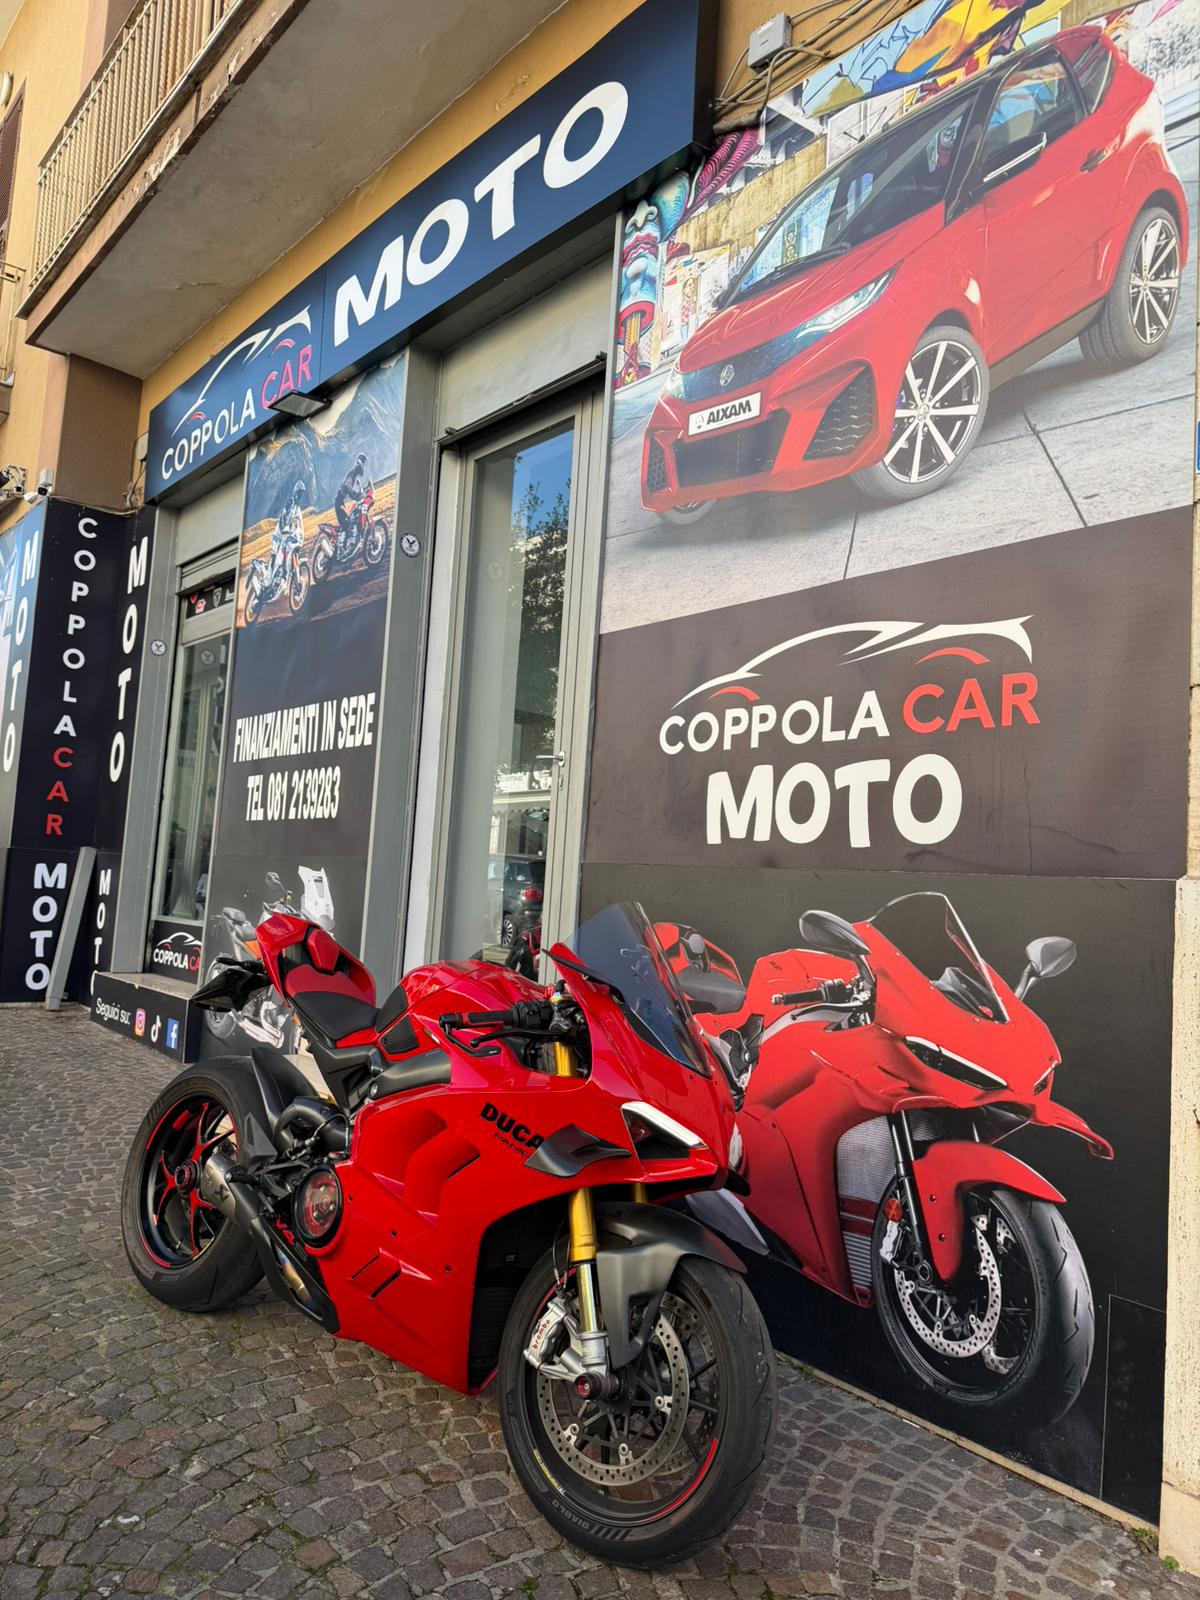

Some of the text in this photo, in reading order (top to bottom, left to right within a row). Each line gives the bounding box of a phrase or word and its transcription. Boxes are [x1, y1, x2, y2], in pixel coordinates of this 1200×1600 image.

[334, 81, 629, 347] MOTO
[162, 345, 313, 480] COPPOLA CAR
[707, 400, 752, 425] AIXAM
[3, 530, 39, 773] MOTO
[109, 536, 148, 783] MOTO
[233, 692, 376, 763] FINANZIAMENTI IN SEDE
[659, 672, 1041, 755] COPPOLA CAR
[246, 765, 341, 821] TEL 081 2139283
[706, 753, 963, 849] MOTO
[25, 862, 67, 991] MOTO
[153, 948, 202, 971] COPPOLA CA
[96, 997, 119, 1021] Seguici
[480, 1102, 545, 1151] DUCA
[531, 1319, 551, 1350] brembo
